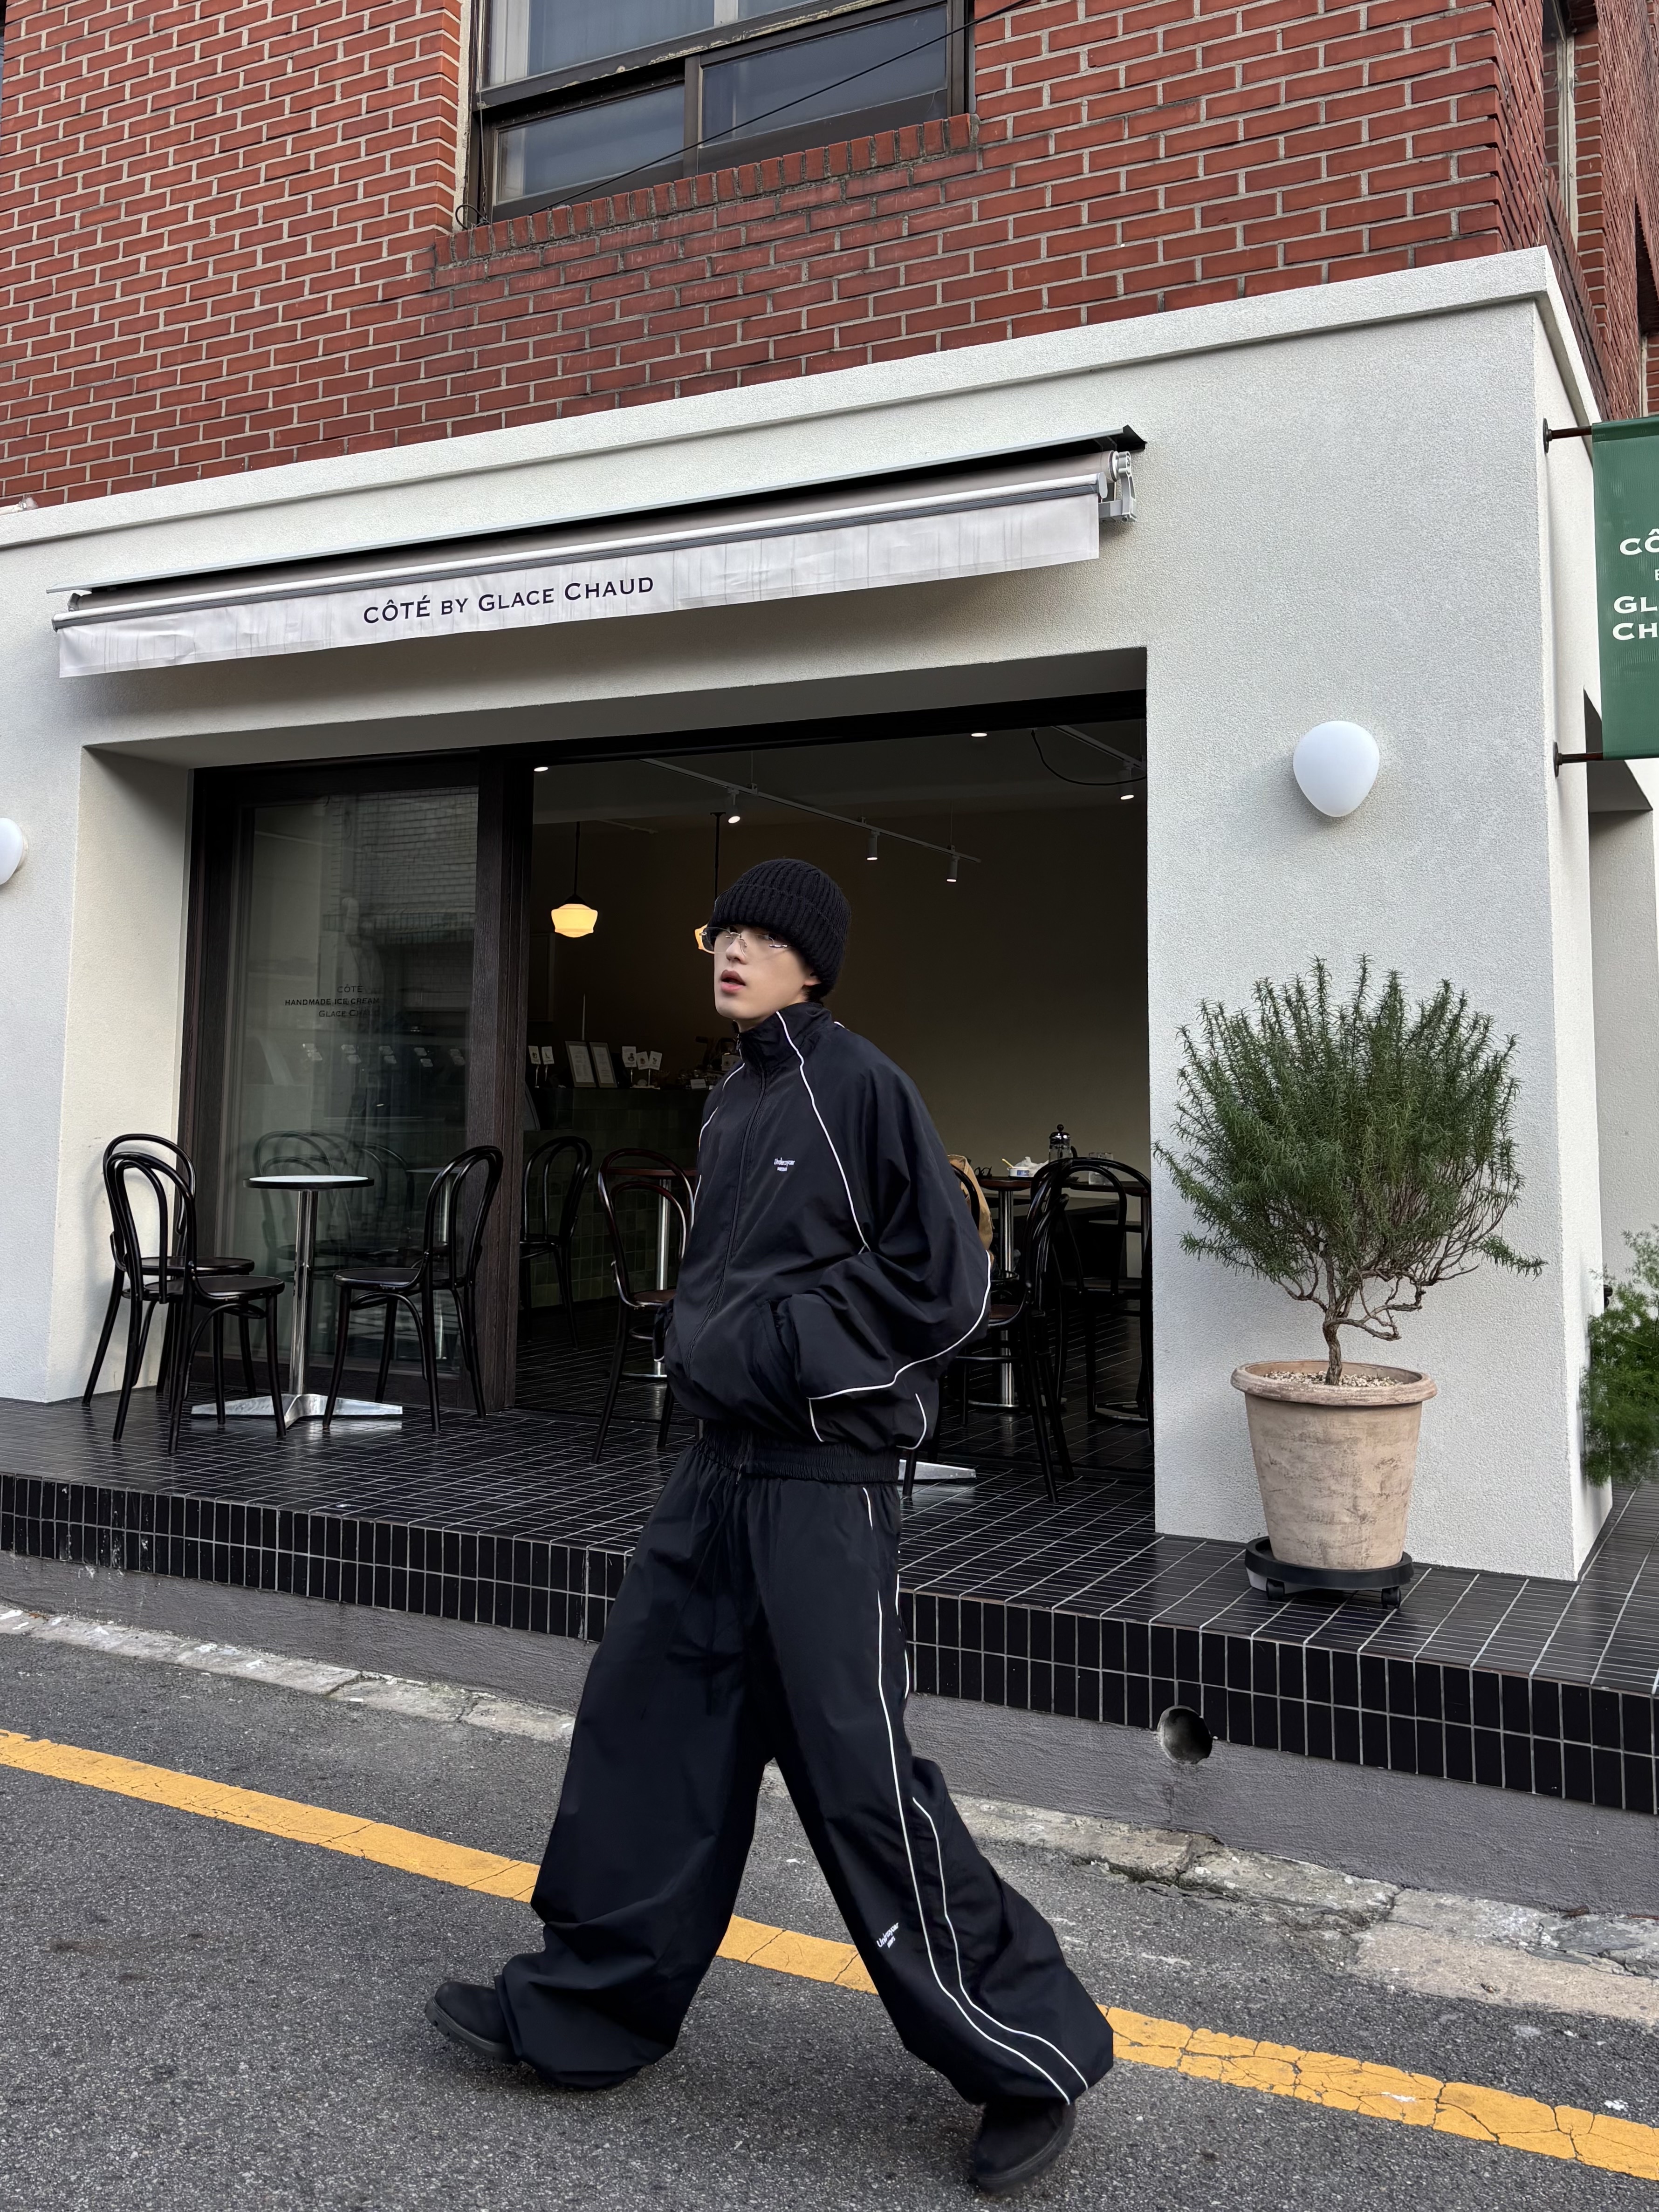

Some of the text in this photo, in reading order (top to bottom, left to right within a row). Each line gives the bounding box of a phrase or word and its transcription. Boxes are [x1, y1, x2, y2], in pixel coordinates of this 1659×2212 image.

[363, 577, 654, 623] CÔTÉ BY GLACE CHAUD
